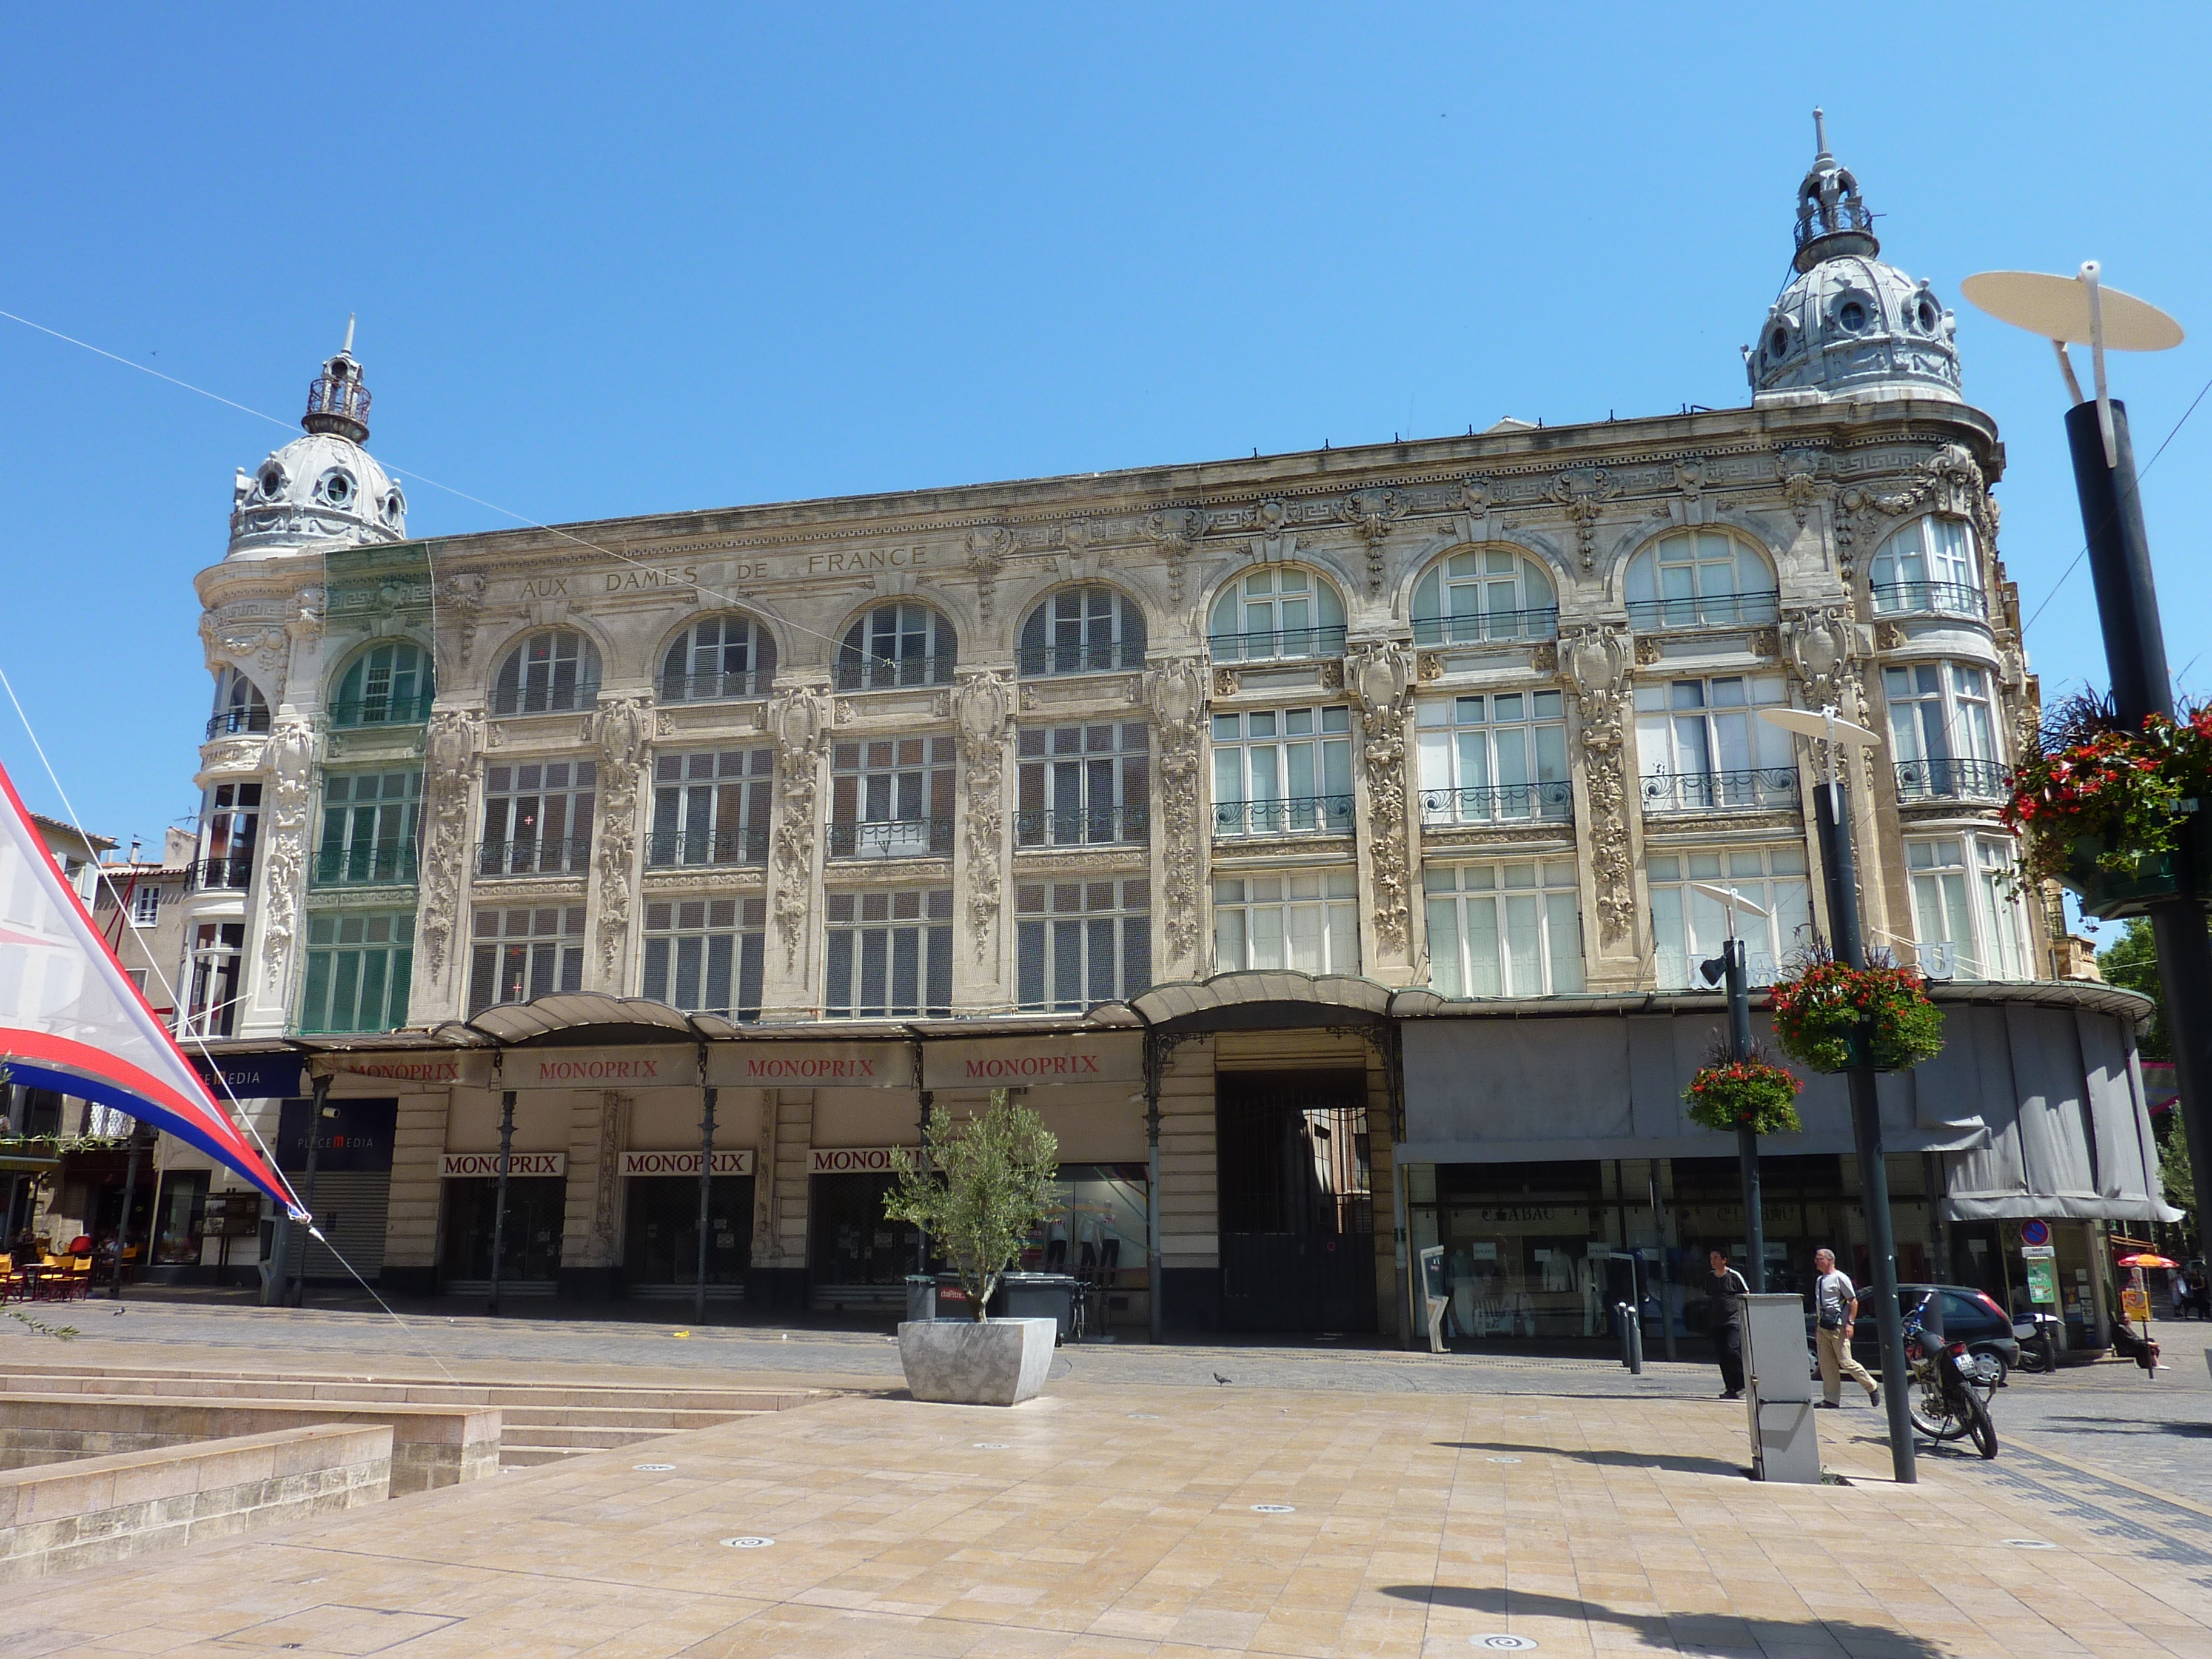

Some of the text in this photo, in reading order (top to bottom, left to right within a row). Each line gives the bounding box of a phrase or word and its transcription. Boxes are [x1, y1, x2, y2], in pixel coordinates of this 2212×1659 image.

[520, 546, 927, 599] AUX DAMES DE FRANCE
[539, 1060, 658, 1080] MONOPRIX
[746, 1059, 875, 1078] MONOPRIX
[966, 1055, 1099, 1078] MONOPRIX
[298, 1135, 374, 1148] PLCEMEDIA
[626, 1154, 745, 1173] MONOPRIX
